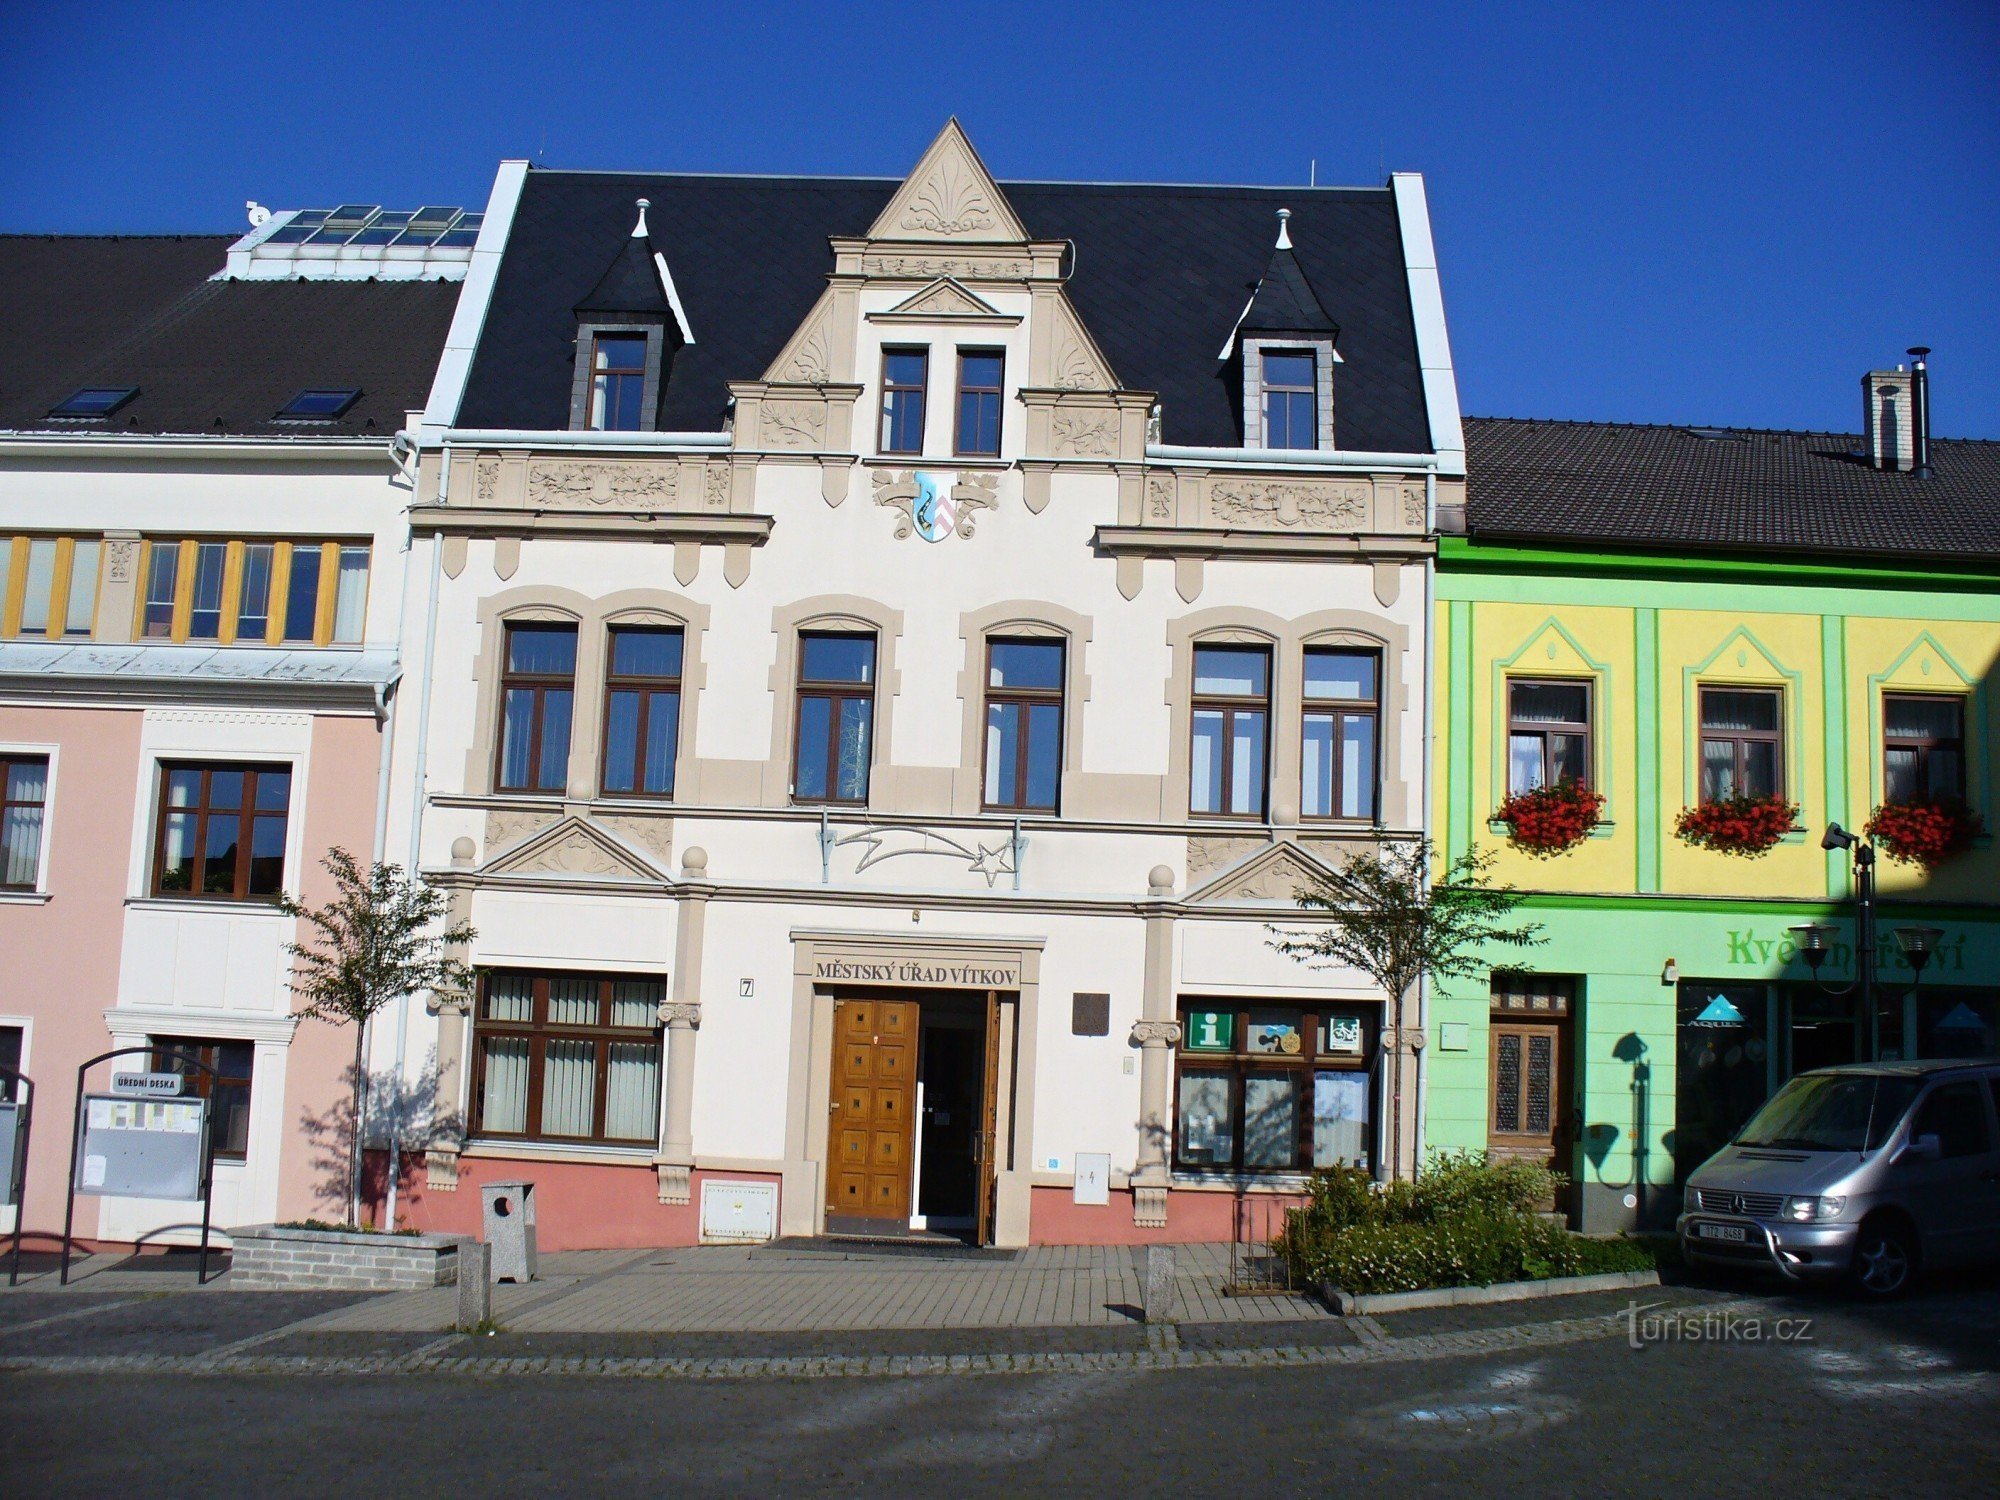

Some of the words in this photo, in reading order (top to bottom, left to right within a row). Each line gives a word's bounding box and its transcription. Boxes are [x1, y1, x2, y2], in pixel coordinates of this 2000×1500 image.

[816, 959, 896, 980] MĚSTSKÝ
[899, 962, 947, 983] ÚŘAD
[950, 965, 1016, 985] VÍTKOV
[743, 981, 752, 995] 7
[118, 1076, 148, 1088] ÚŘEDNÍ
[150, 1080, 175, 1089] DESKA
